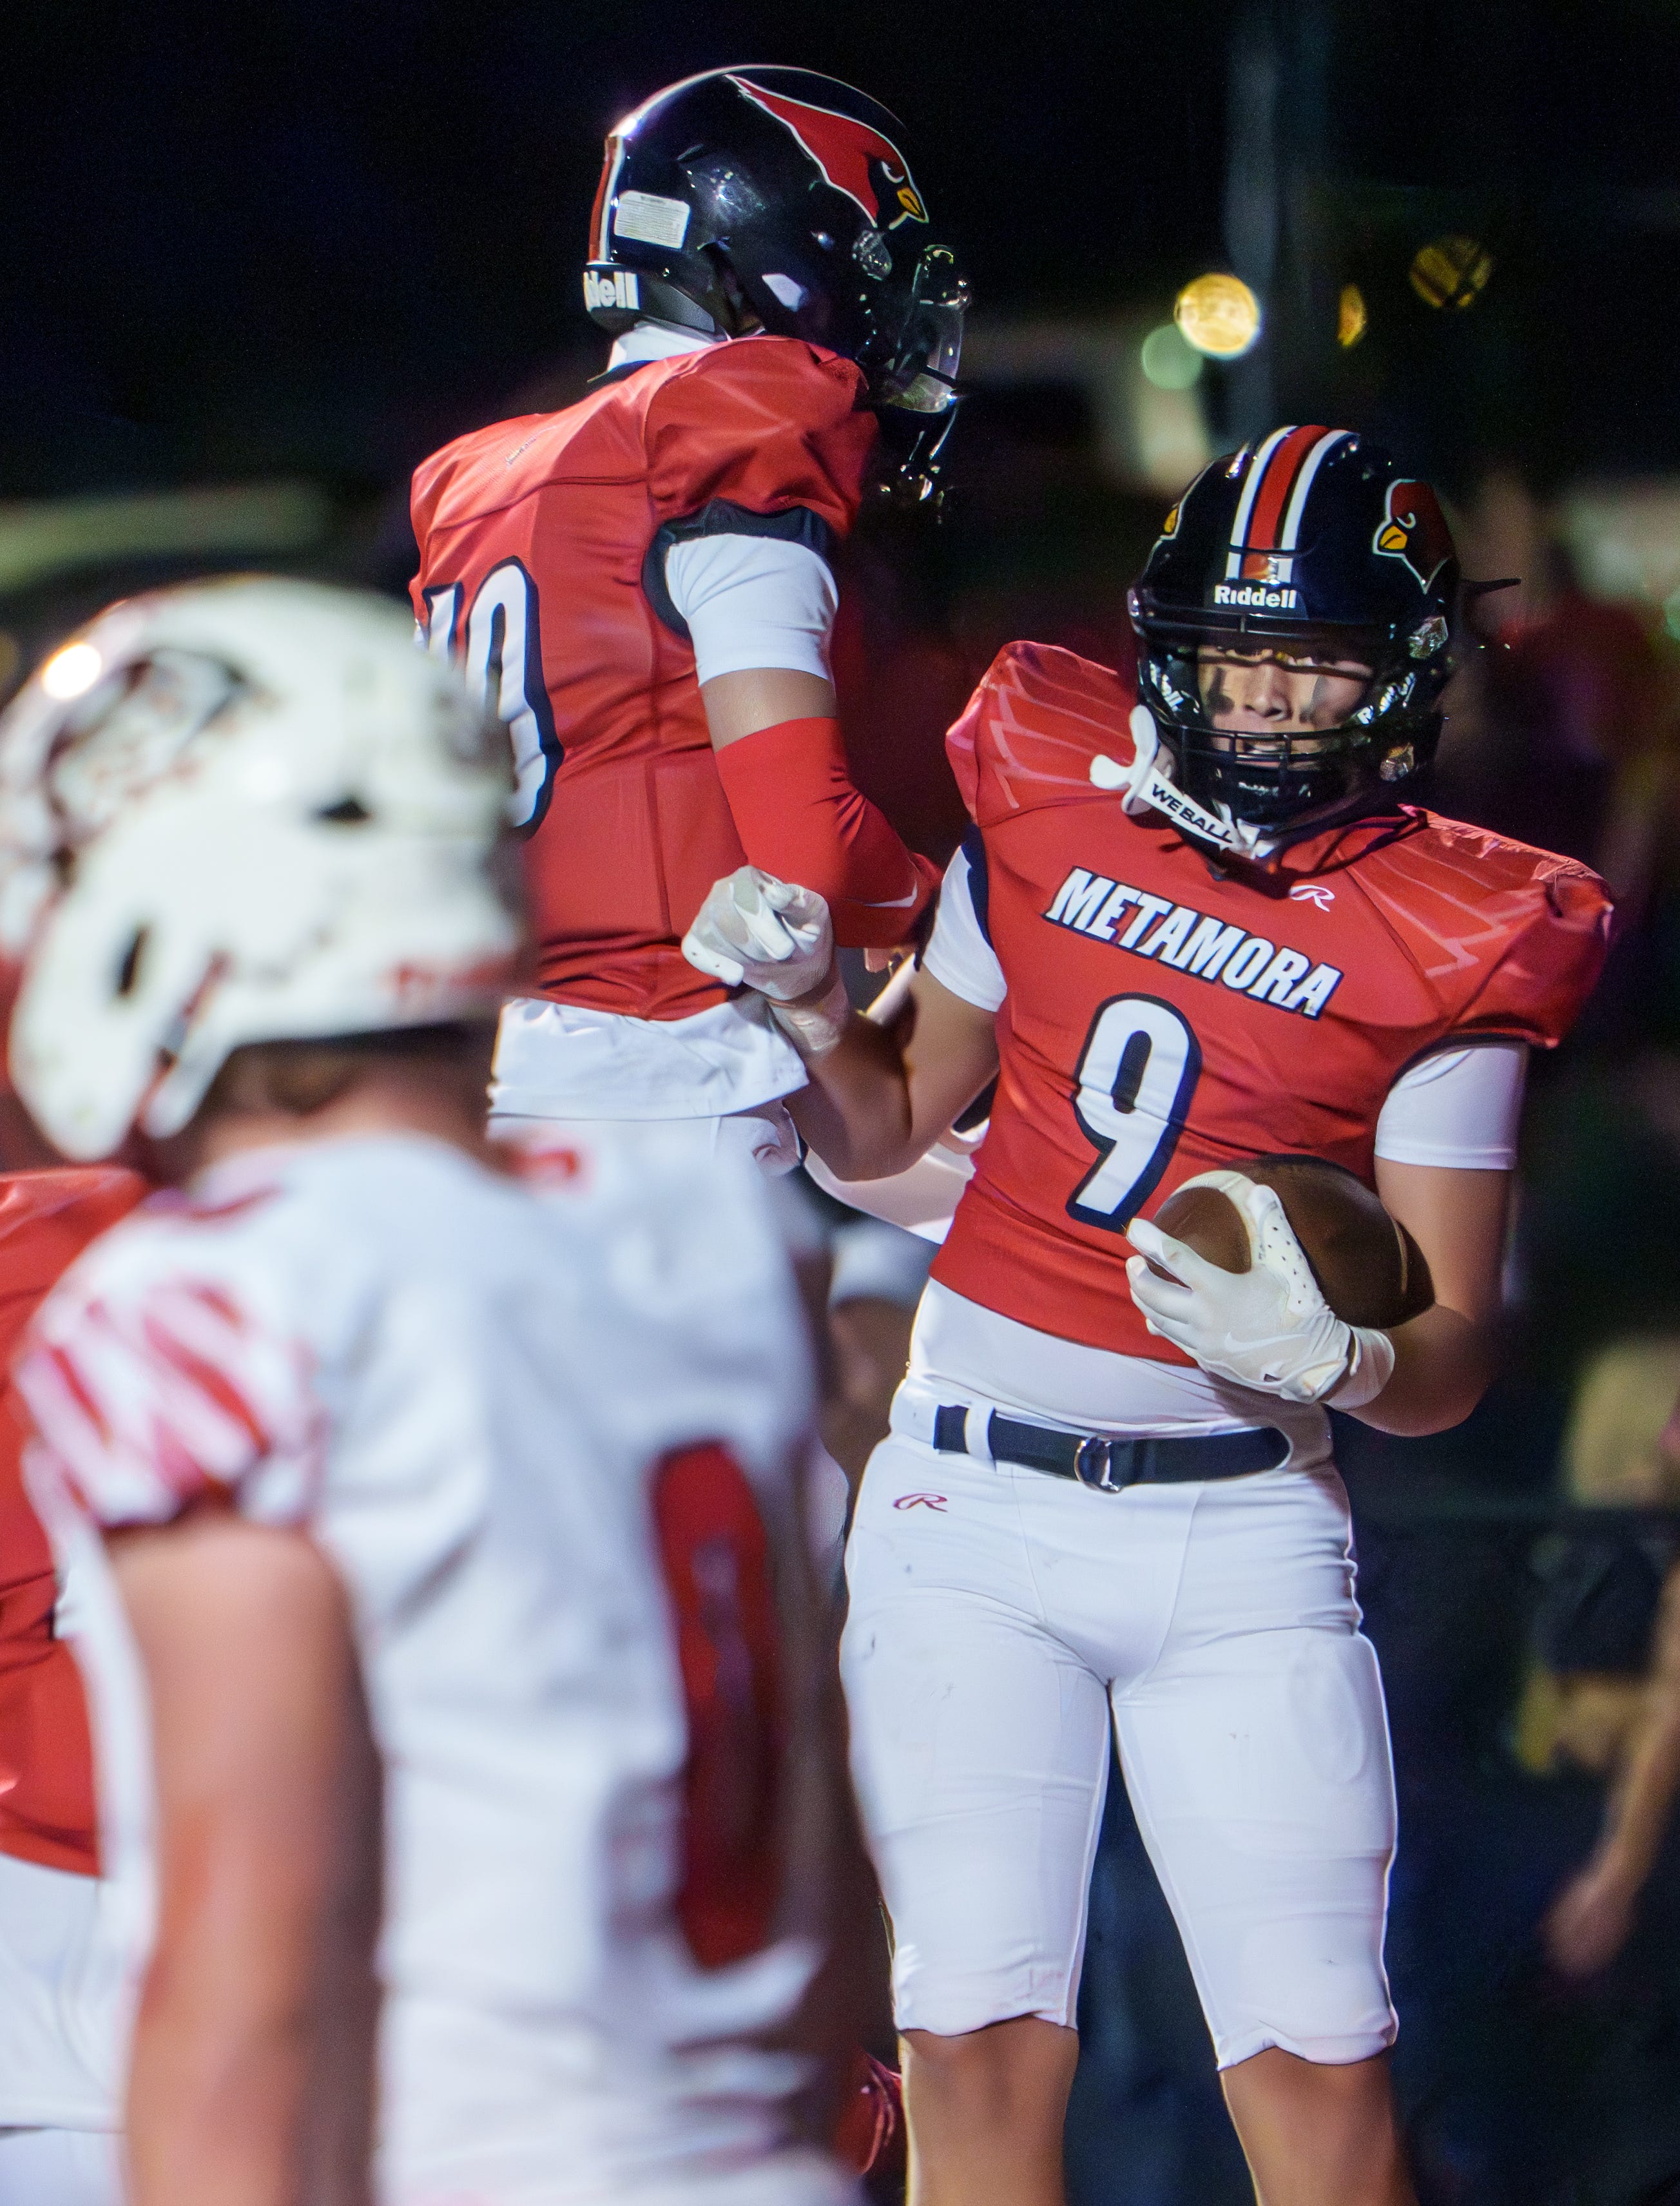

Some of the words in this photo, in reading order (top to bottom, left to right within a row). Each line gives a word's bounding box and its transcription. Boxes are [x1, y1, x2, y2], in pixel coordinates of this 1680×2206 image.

[1214, 584, 1297, 608] Riddell
[1041, 866, 1344, 1020] METAMORA
[1065, 991, 1203, 1232] 9
